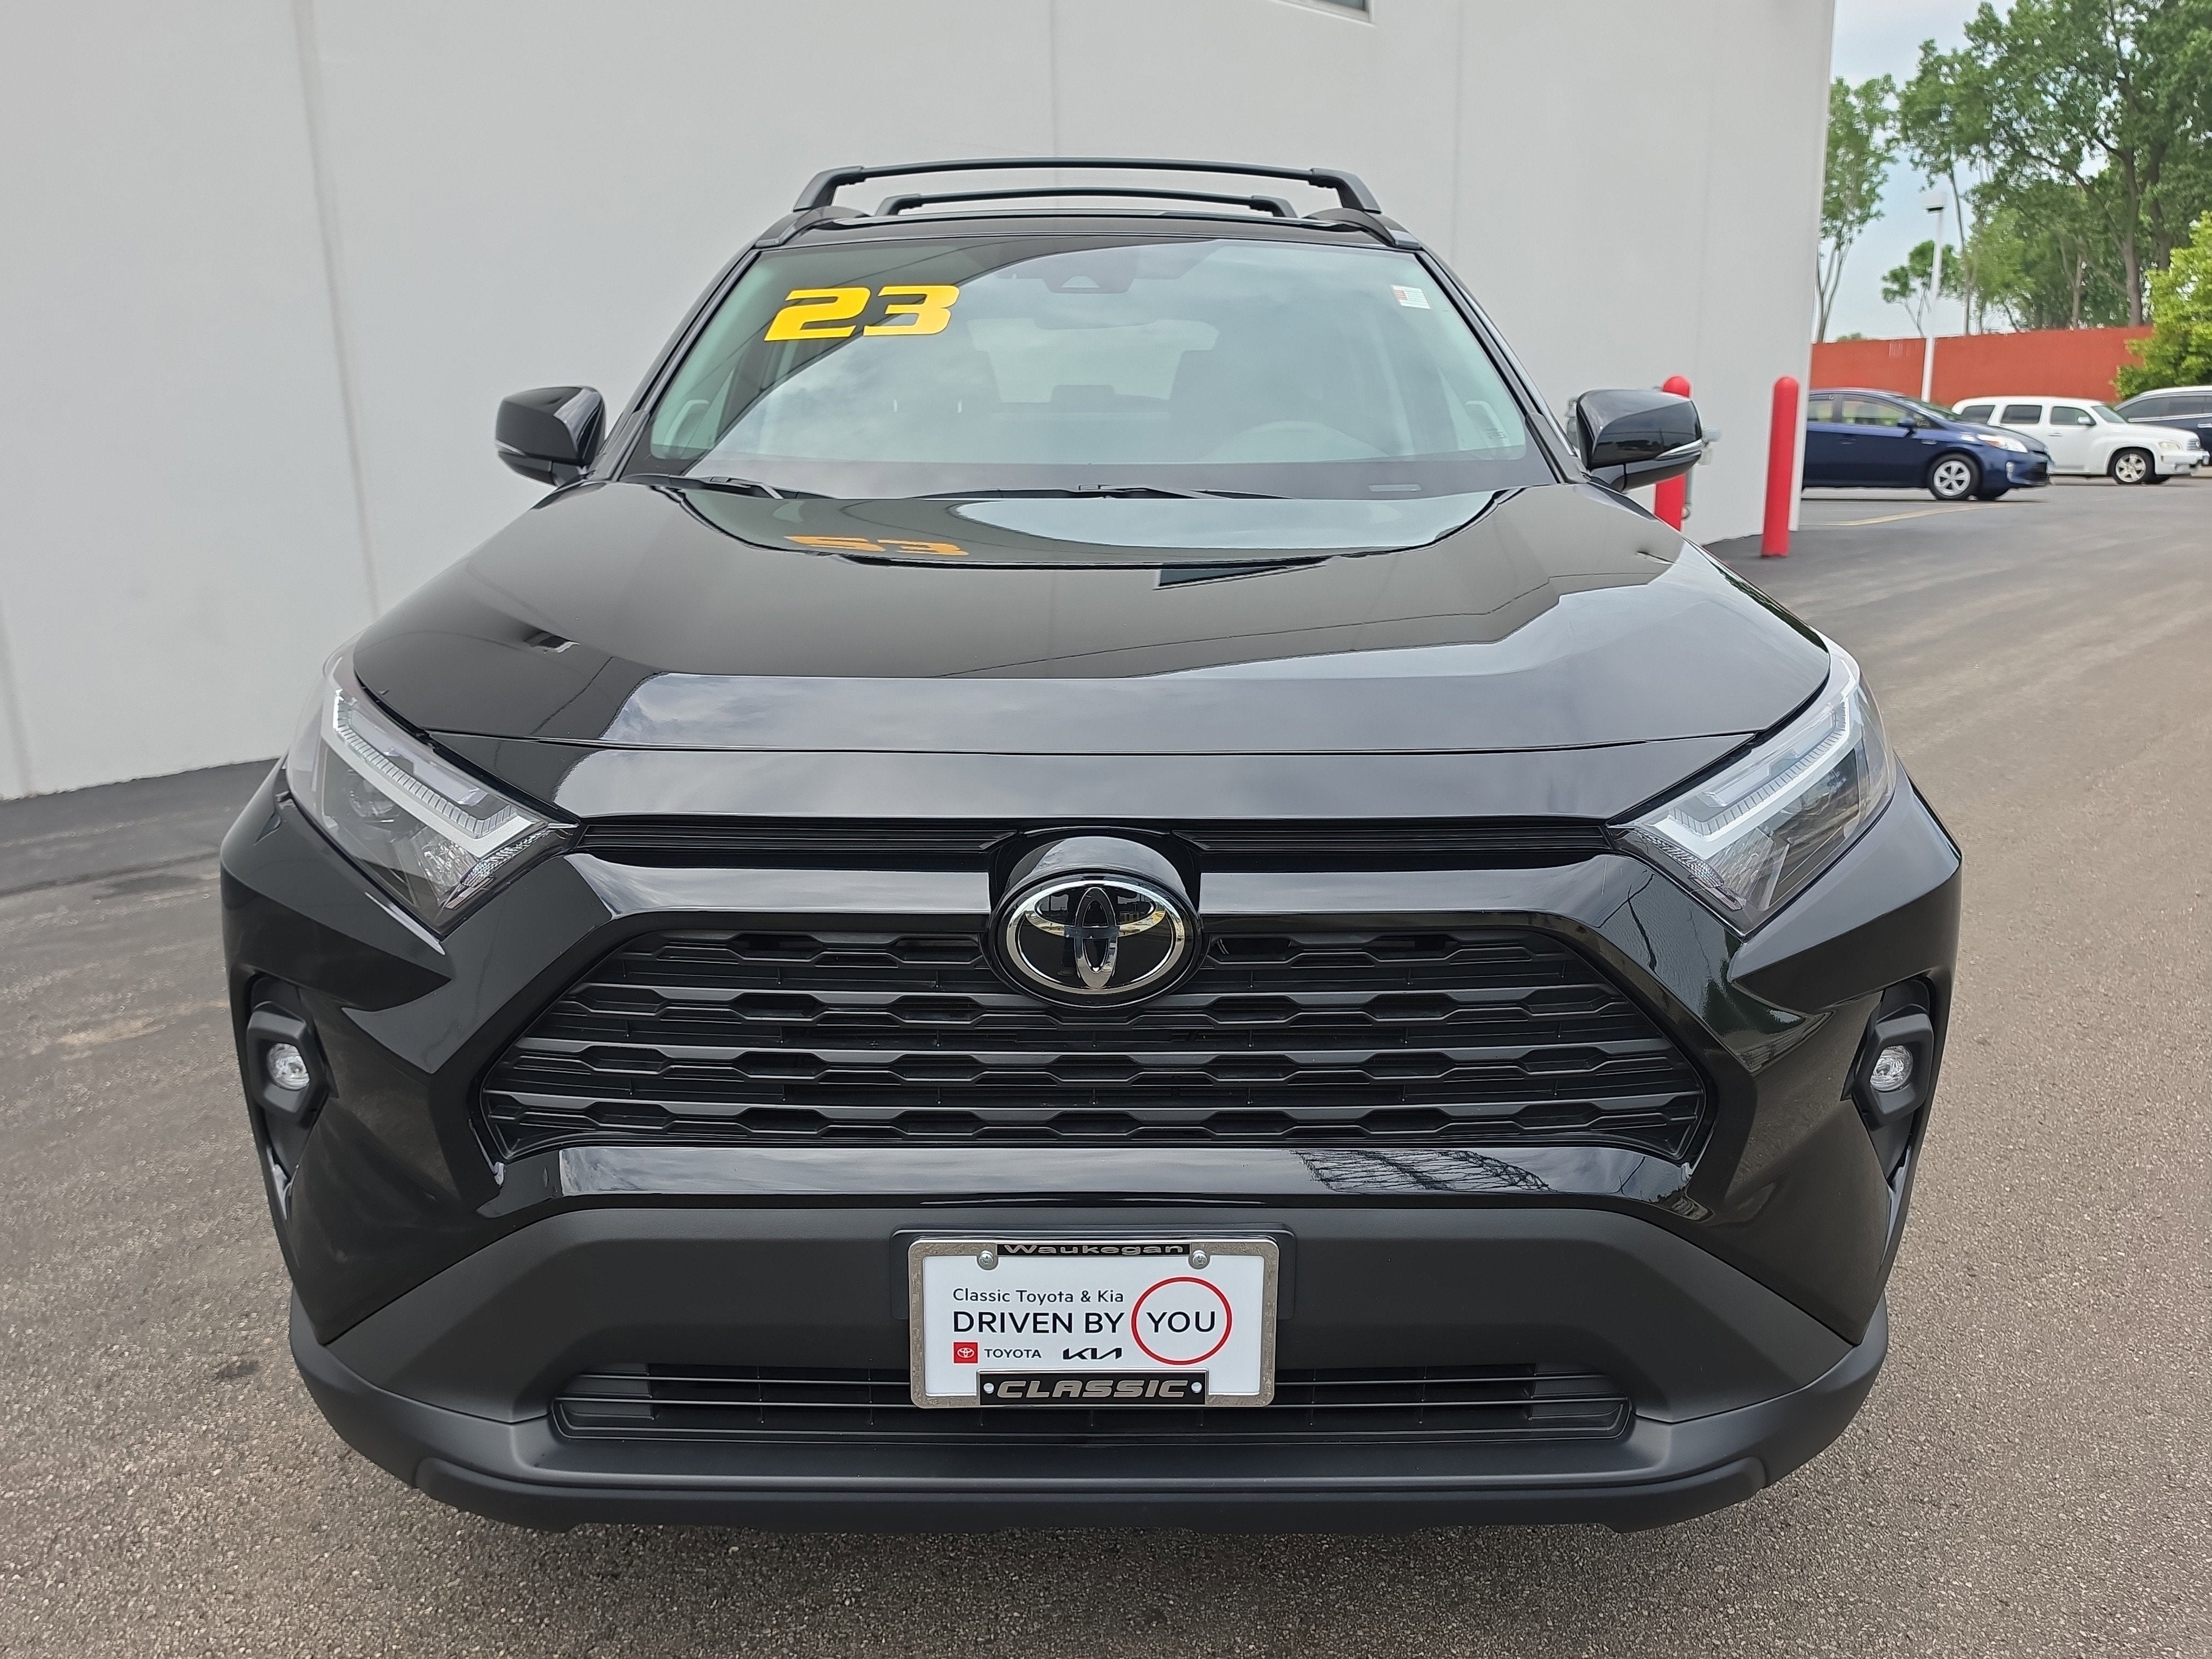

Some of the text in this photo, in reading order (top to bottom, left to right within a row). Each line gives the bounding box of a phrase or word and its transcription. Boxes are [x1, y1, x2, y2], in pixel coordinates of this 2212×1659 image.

[764, 285, 960, 341] 23
[1004, 1245, 1183, 1255] Waukegan
[953, 1288, 1123, 1306] Classic Toyota & Kia
[954, 1311, 1216, 1333] DRIVEN BY YOU
[984, 1347, 1122, 1360] TOYOTA KIA
[996, 1380, 1188, 1398] CLASSIC
